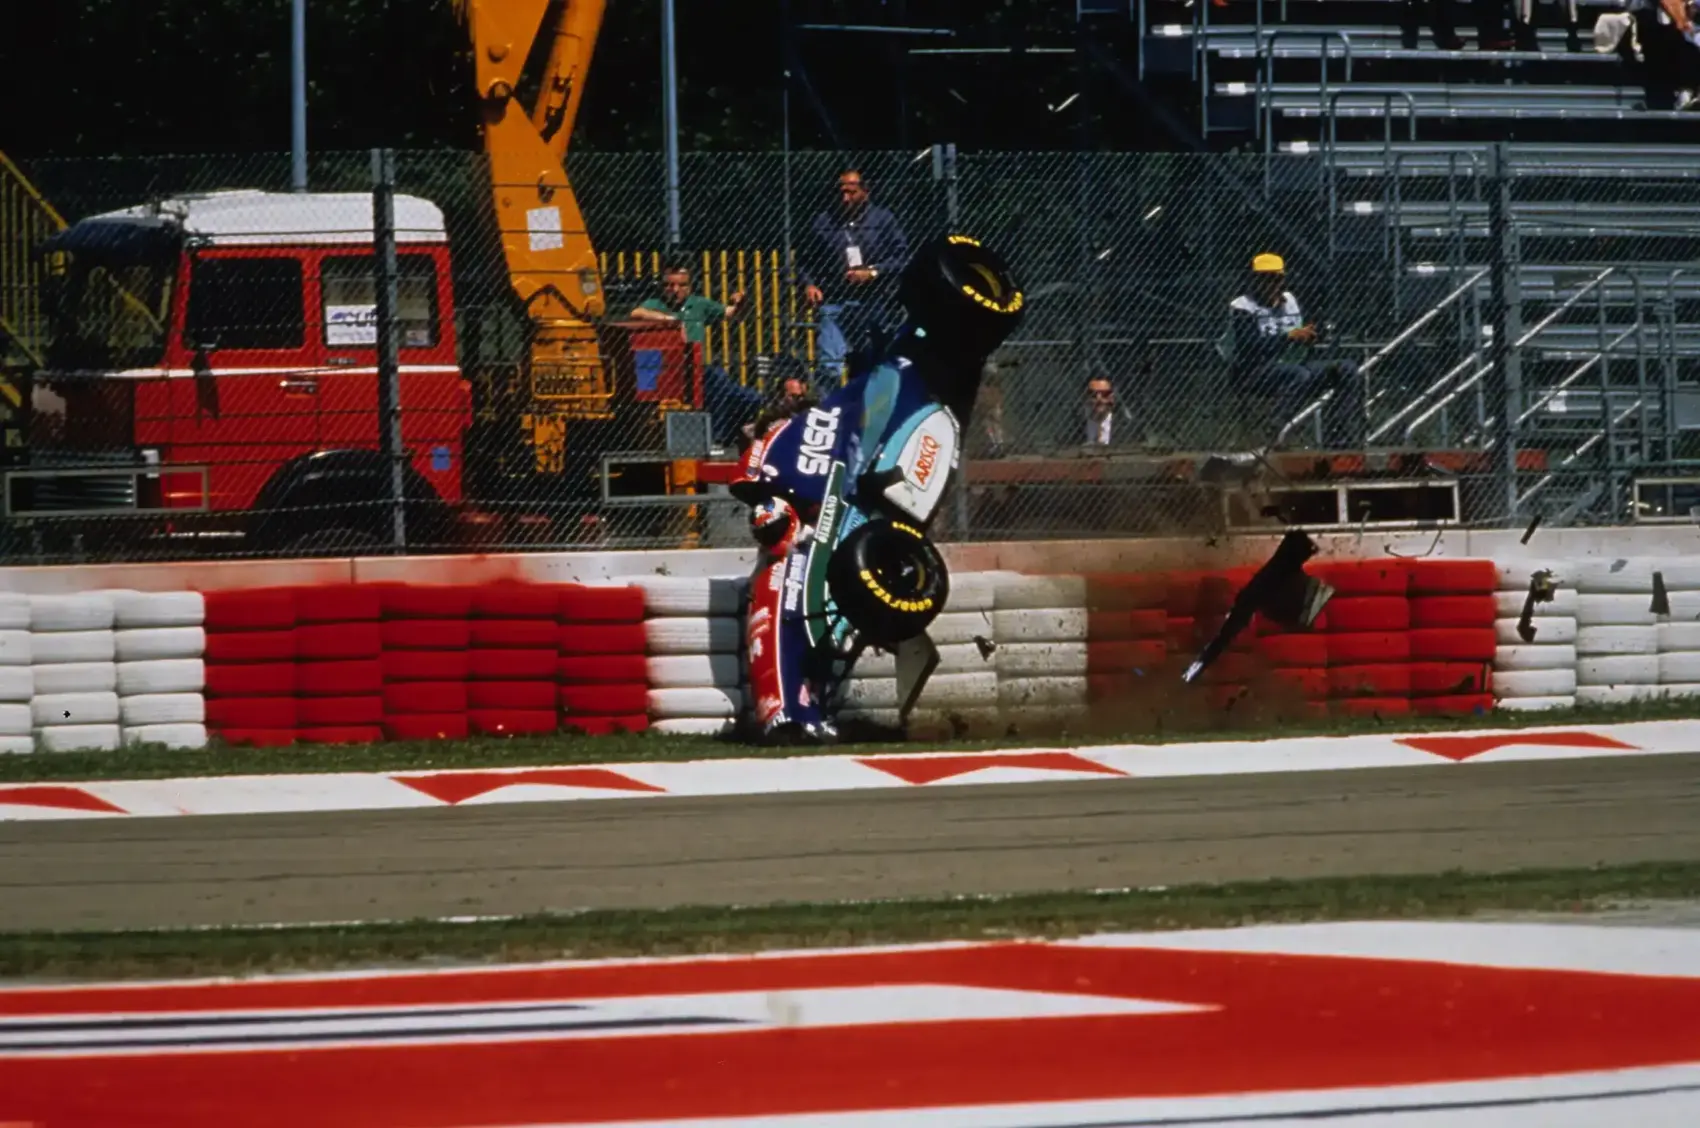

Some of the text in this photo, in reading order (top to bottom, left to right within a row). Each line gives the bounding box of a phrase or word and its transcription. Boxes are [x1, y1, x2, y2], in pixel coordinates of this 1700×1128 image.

[797, 407, 842, 475] SASOL
[915, 435, 941, 485] ARISCO
[818, 495, 839, 540] IRELAND
